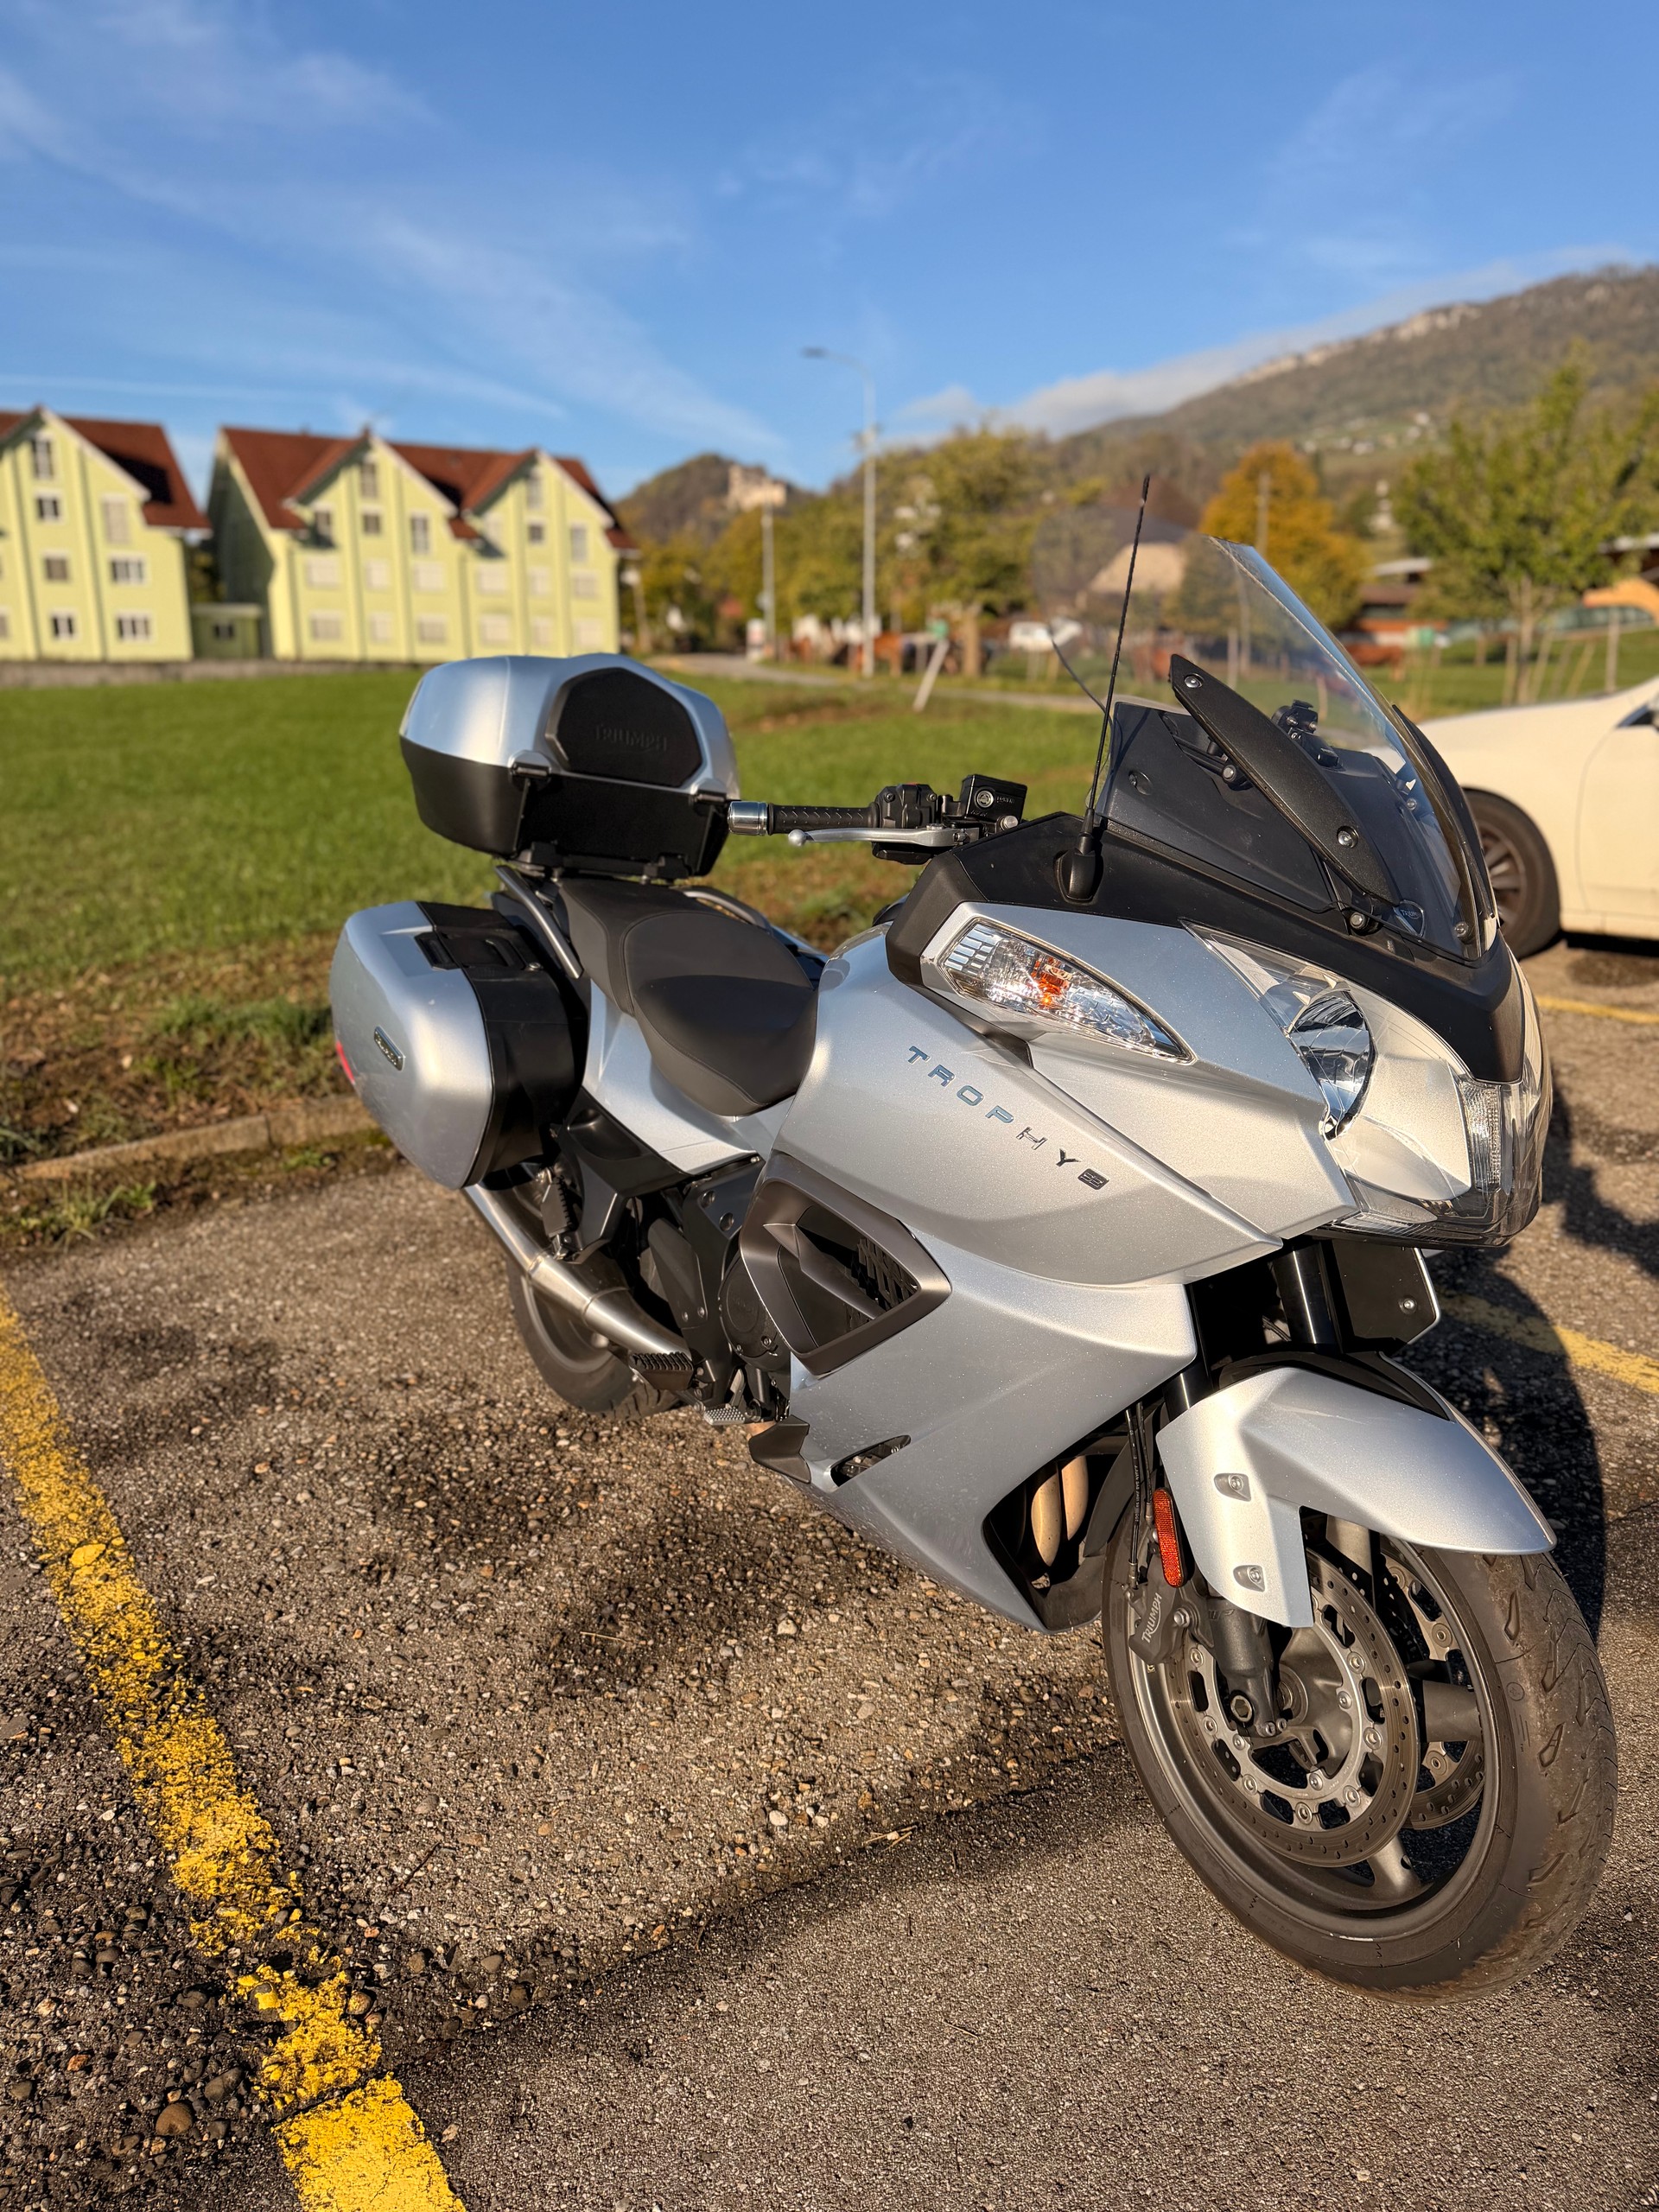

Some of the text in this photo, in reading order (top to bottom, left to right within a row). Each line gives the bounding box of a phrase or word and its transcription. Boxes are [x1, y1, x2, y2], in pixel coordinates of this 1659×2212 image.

[594, 723, 668, 753] TRIUMPH
[907, 1046, 1108, 1190] TROPHY SE
[1141, 1592, 1162, 1643] TRIUMPH
